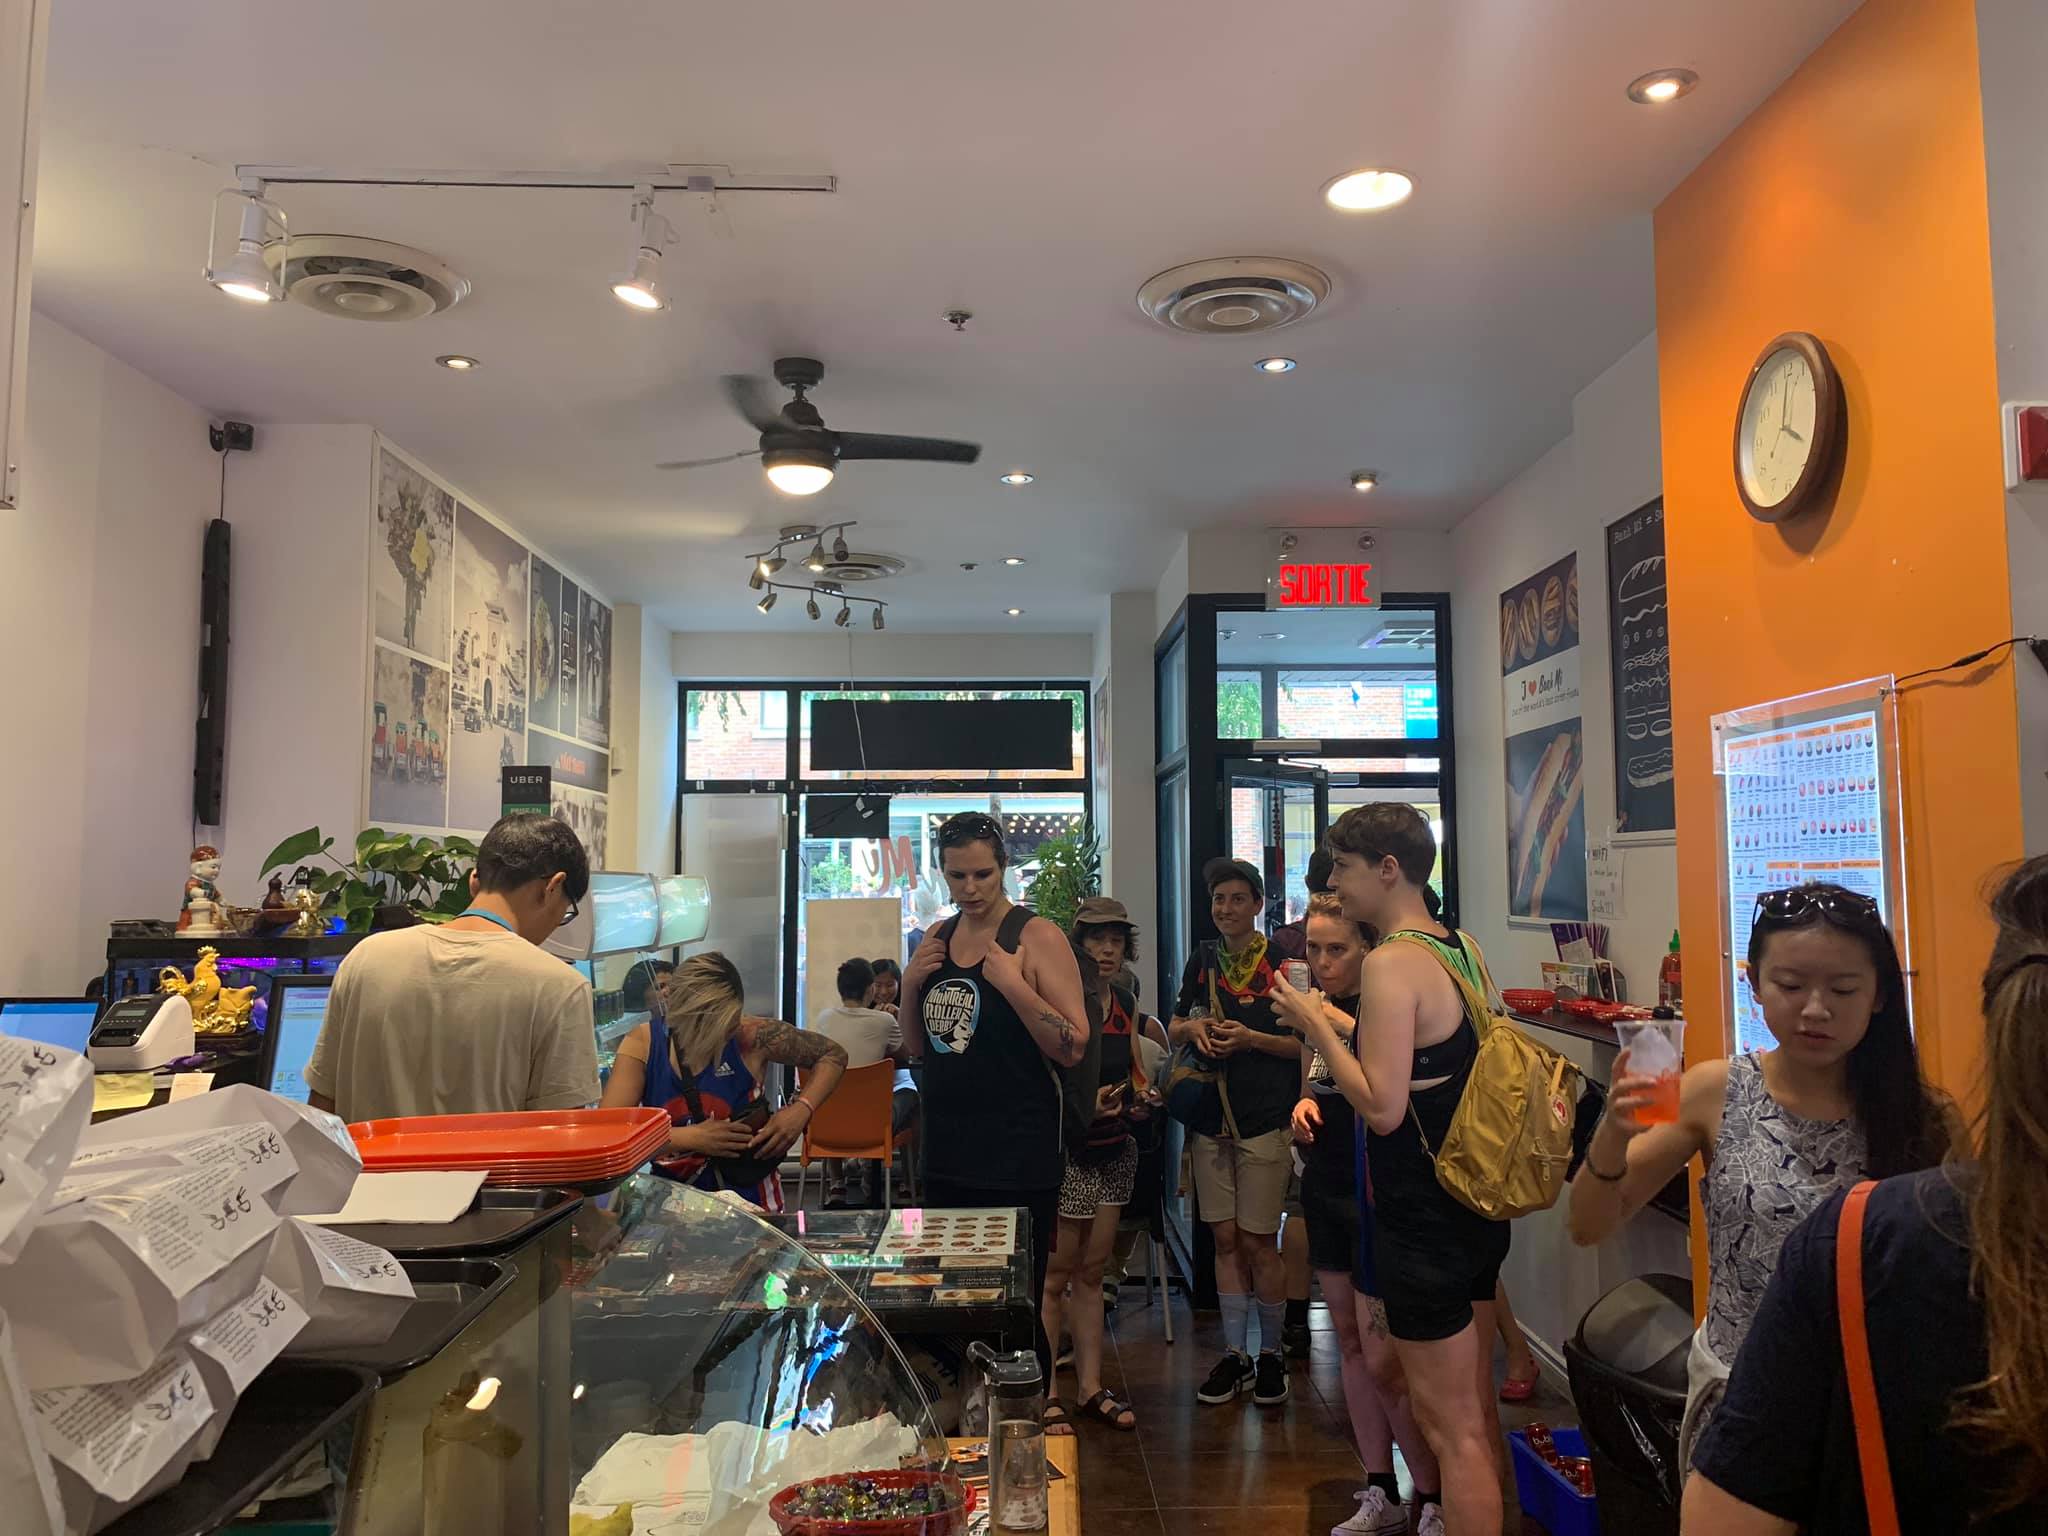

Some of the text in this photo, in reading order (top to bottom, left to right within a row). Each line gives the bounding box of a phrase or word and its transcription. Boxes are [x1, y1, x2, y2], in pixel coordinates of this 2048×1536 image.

[1279, 563, 1374, 606] SORTIE
[510, 775, 543, 784] UBER
[926, 1003, 963, 1020] ROLLER
[929, 1018, 954, 1033] DERBY
